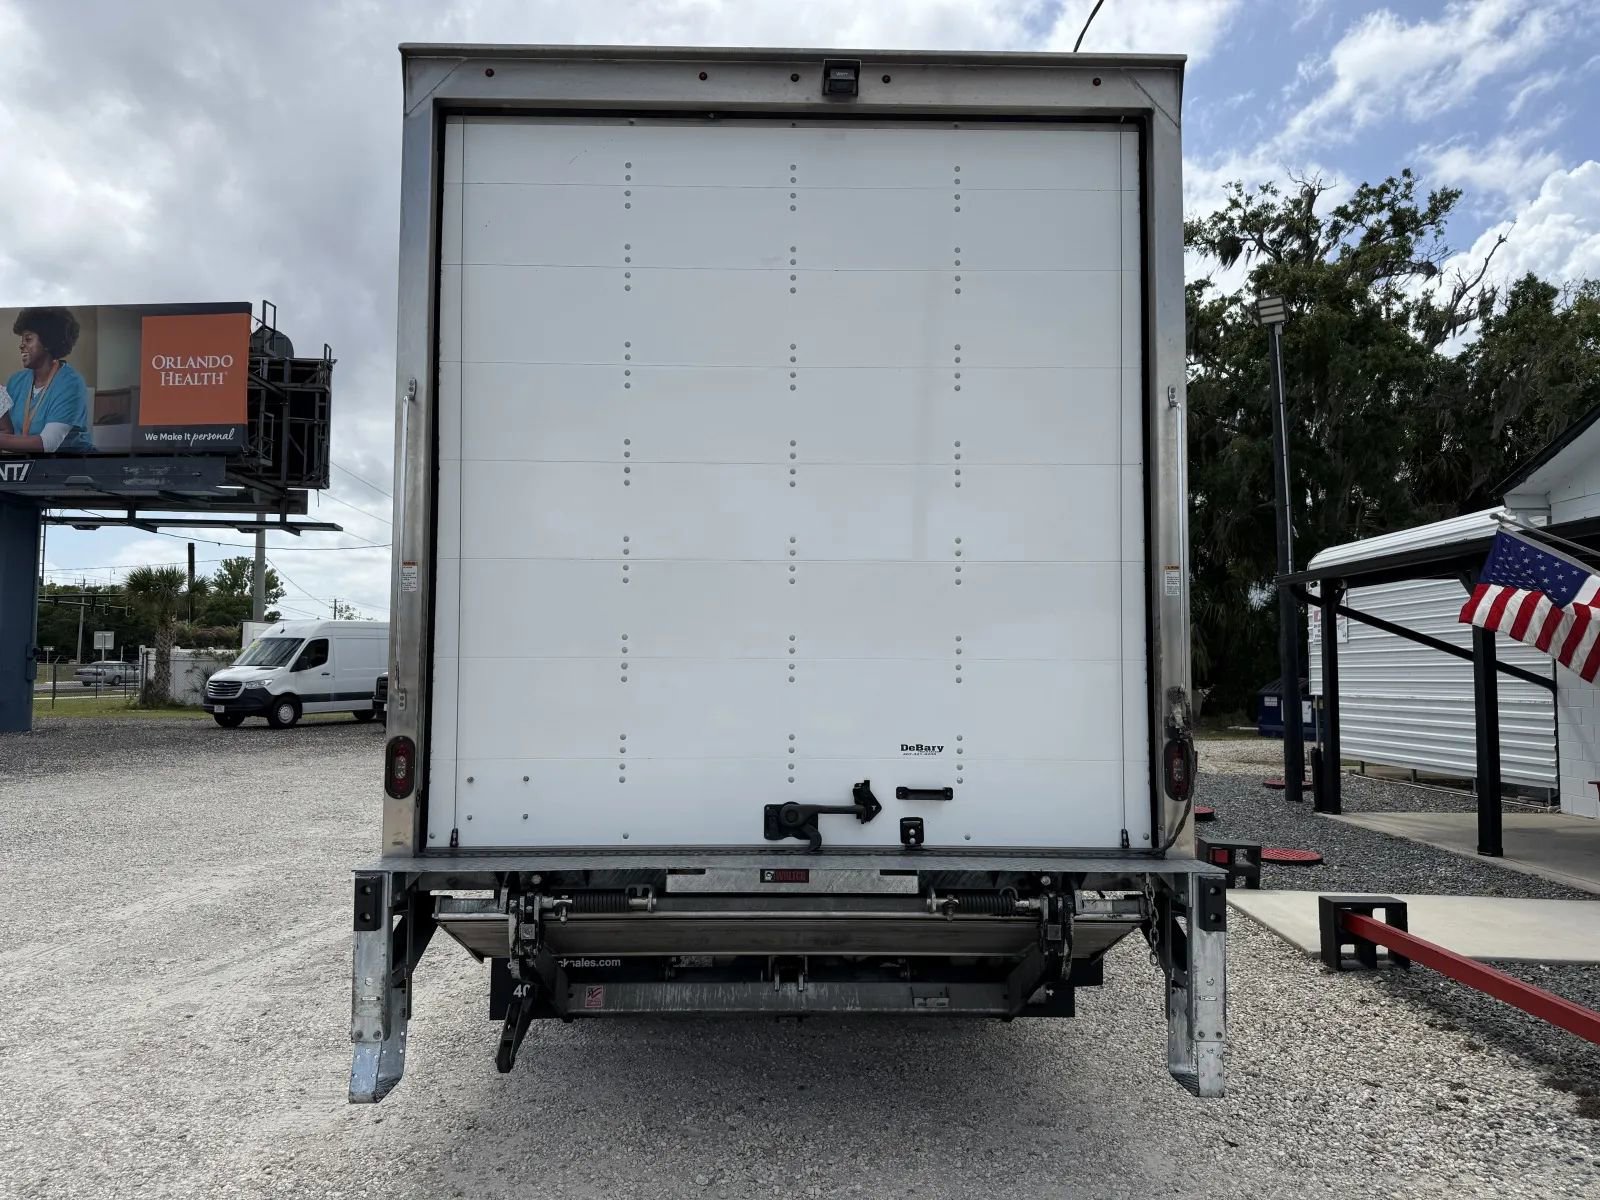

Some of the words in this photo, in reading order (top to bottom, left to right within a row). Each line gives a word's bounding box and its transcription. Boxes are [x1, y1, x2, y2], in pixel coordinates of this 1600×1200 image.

[151, 354, 234, 370] ORLANDO
[160, 371, 225, 386] HEALTH
[144, 432, 158, 441] We
[159, 432, 183, 441] Make
[184, 432, 191, 441] It
[189, 427, 236, 447] personal
[900, 743, 945, 753] DeBary
